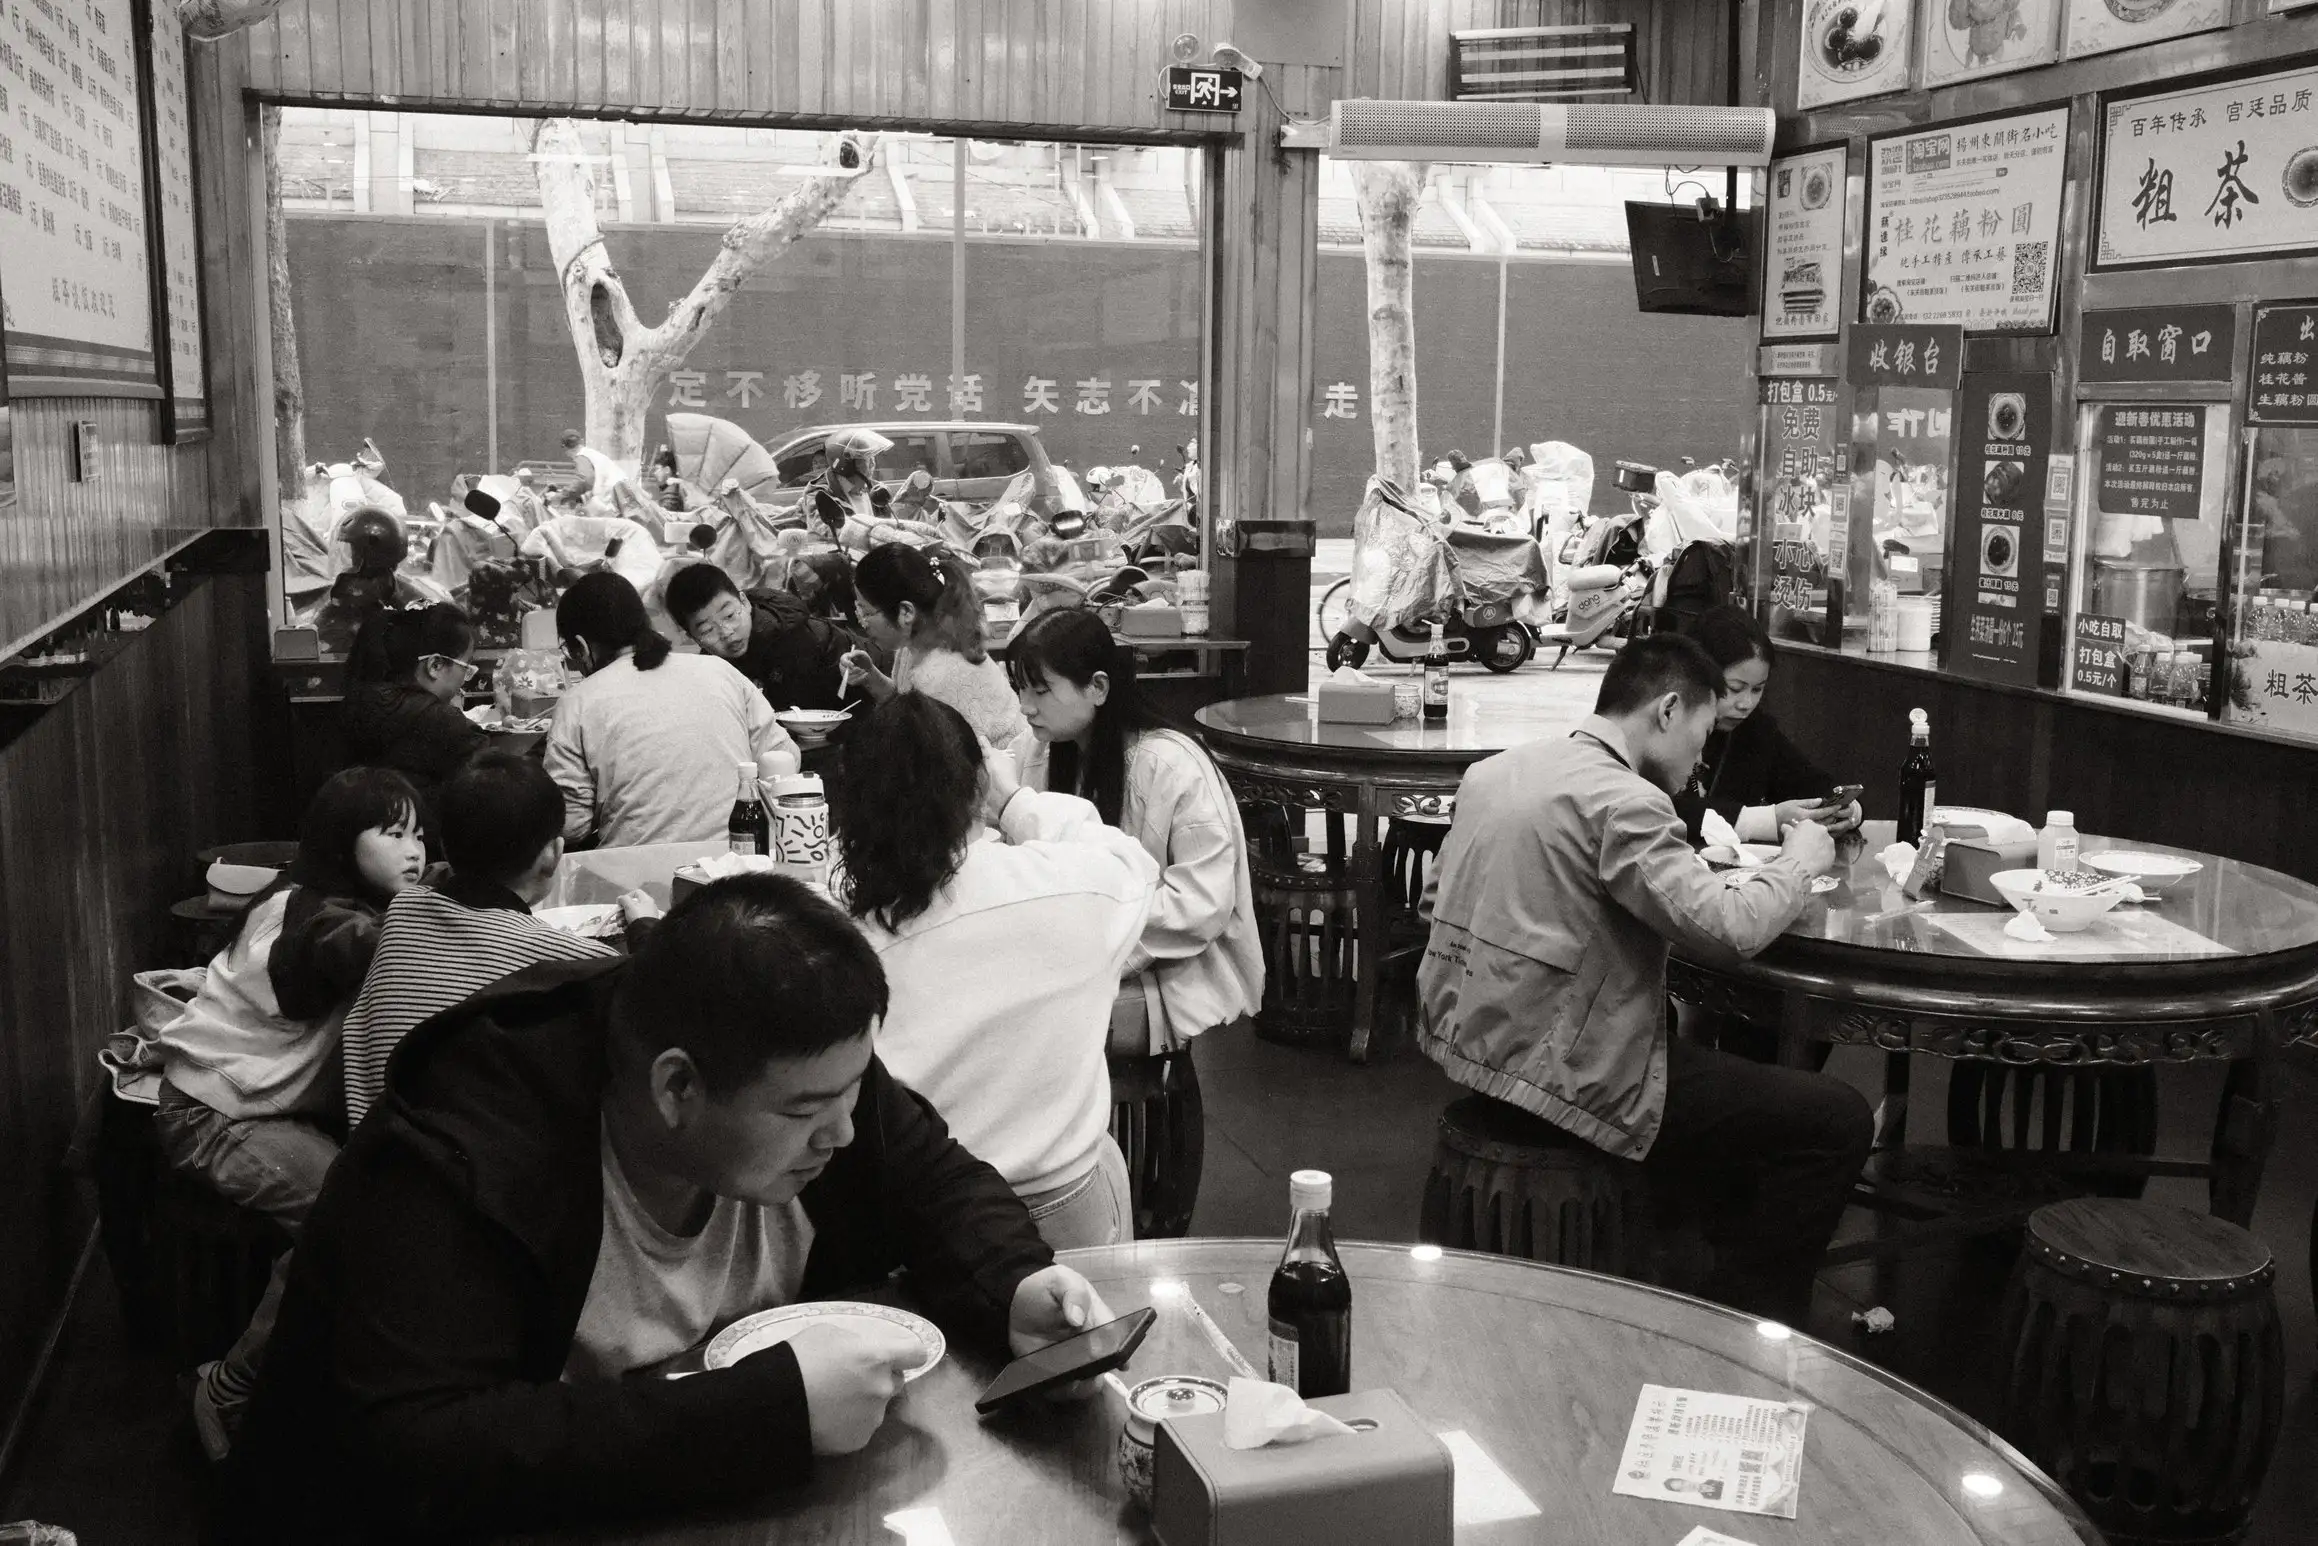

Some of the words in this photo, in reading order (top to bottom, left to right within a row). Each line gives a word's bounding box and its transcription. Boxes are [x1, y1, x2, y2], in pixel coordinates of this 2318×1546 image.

[2131, 108, 2207, 137] 百年传承
[2226, 88, 2312, 123] 宫廷品质
[1911, 136, 1951, 159] 淘宝网
[2132, 140, 2259, 232] 粗茶
[2102, 324, 2212, 364] 自取窗口
[2300, 315, 2315, 341] 出
[1869, 336, 1940, 375] 收银台
[2260, 352, 2309, 365] 纯藕粉
[668, 368, 984, 413] 定不移听党话
[1323, 381, 1359, 419] 走
[1767, 380, 1804, 404] 打包盒
[1808, 383, 1838, 403] 0.5元/
[2259, 372, 2308, 386] 桂花酱
[1782, 405, 1821, 441] 免费
[2115, 411, 2196, 428] 迎新春优惠活动
[1782, 444, 1818, 479] 自助
[1778, 484, 1817, 518] 冰块
[1773, 536, 1814, 573] 小心
[1773, 574, 1813, 611] 烫伤
[2078, 618, 2123, 639] 小吃自取
[2079, 646, 2116, 669] 打包盒
[2077, 670, 2117, 689] 0.5元/个
[2264, 669, 2318, 705] 粗茶
